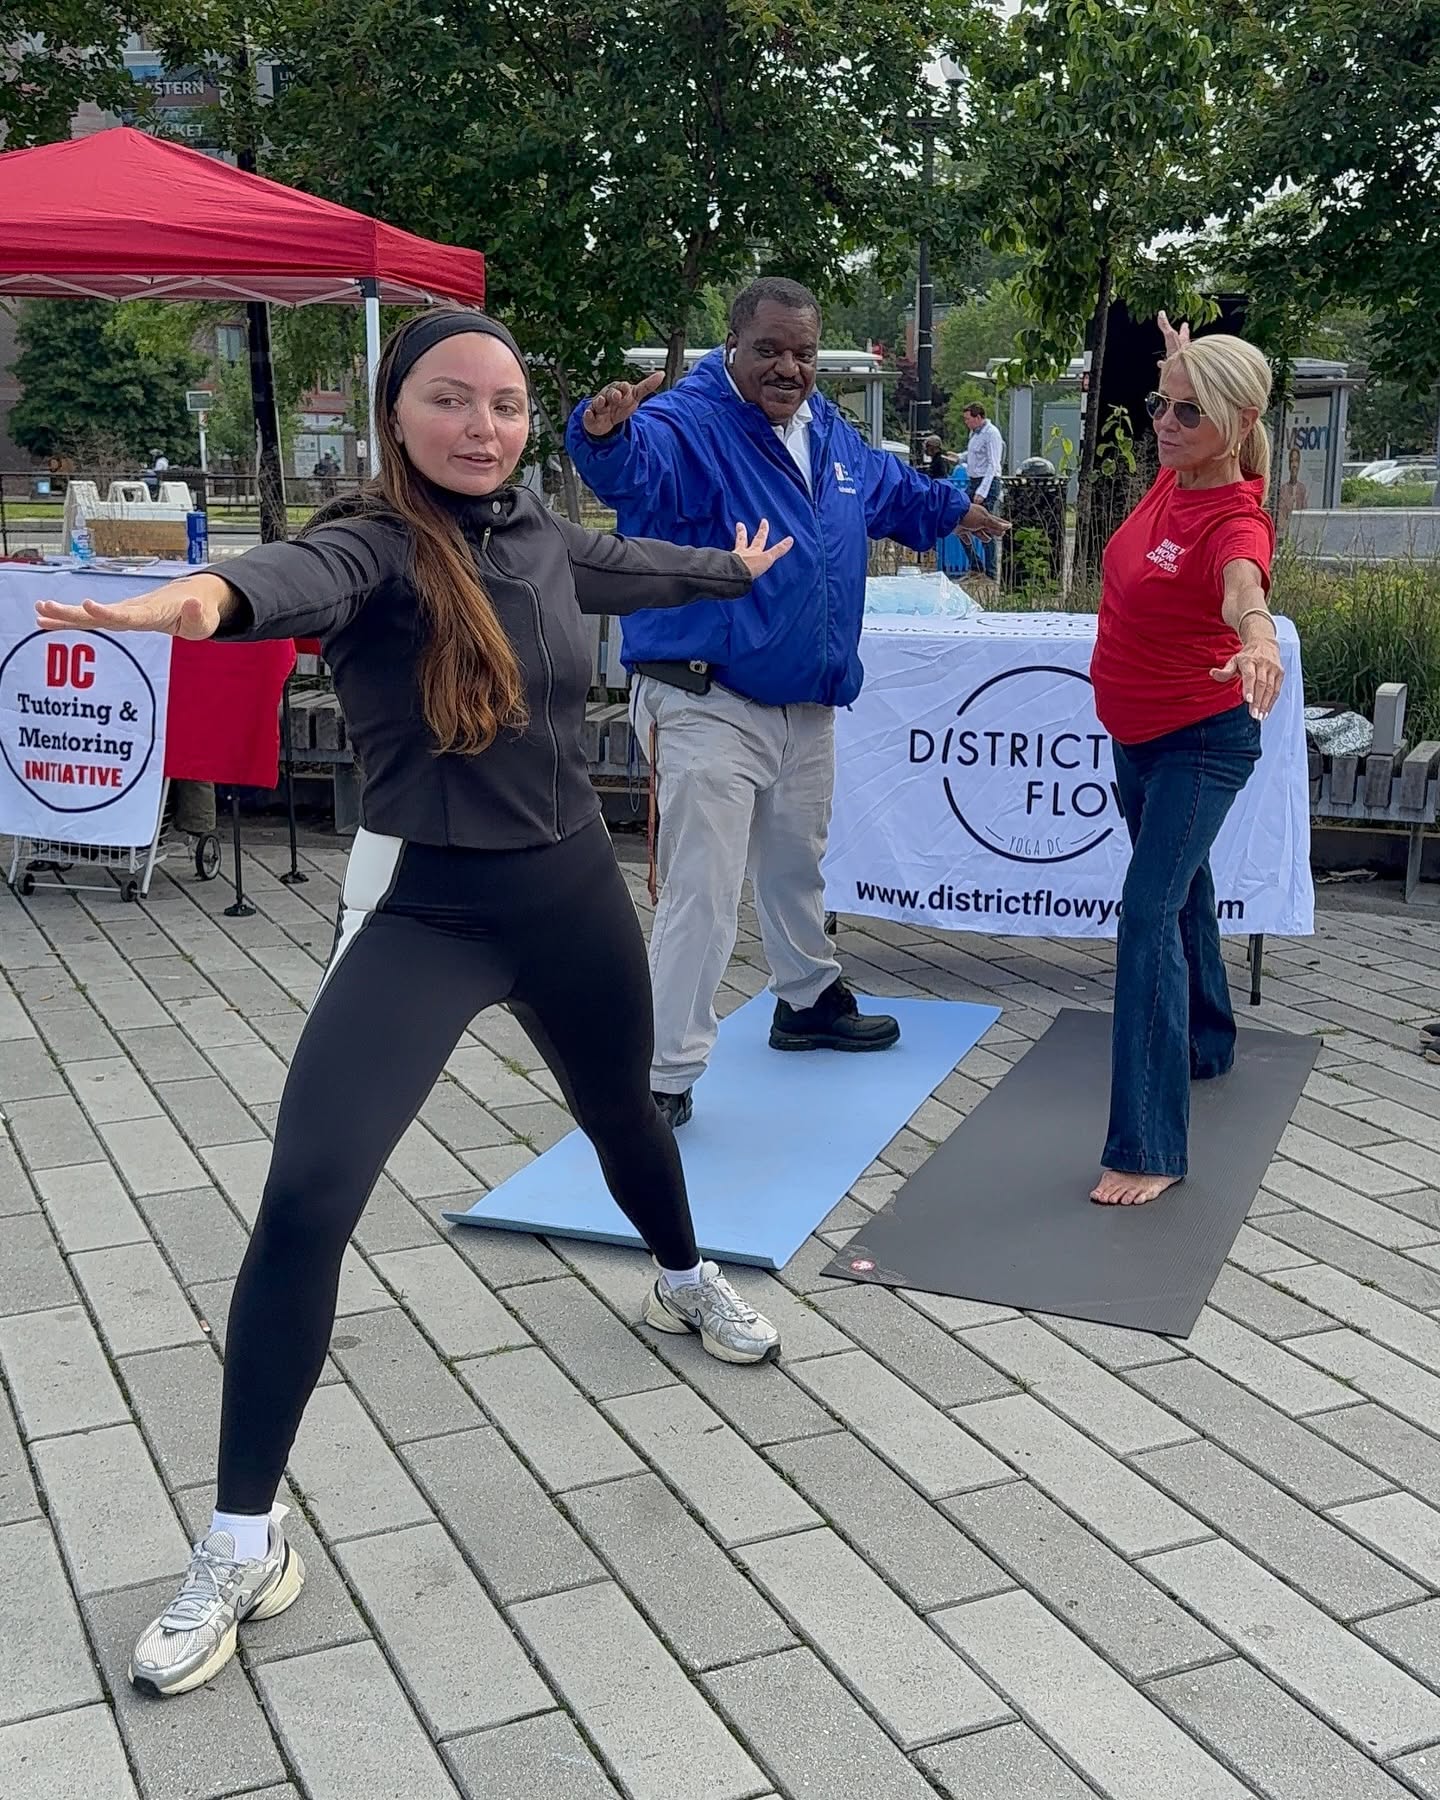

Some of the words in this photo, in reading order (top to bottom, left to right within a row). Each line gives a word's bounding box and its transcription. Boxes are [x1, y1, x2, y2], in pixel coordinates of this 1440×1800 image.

[134, 80, 204, 95] ASTERN
[279, 71, 296, 81] LIV
[1160, 538, 1181, 554] BIKE
[47, 643, 95, 689] DC
[17, 693, 112, 725] Tutoring
[119, 701, 138, 722] &
[18, 727, 134, 761] Mentoring
[909, 728, 1108, 769] DISTRICT
[25, 761, 123, 787] INITIATIVE
[1009, 835, 1040, 856] YOGA
[1046, 836, 1064, 855] DC
